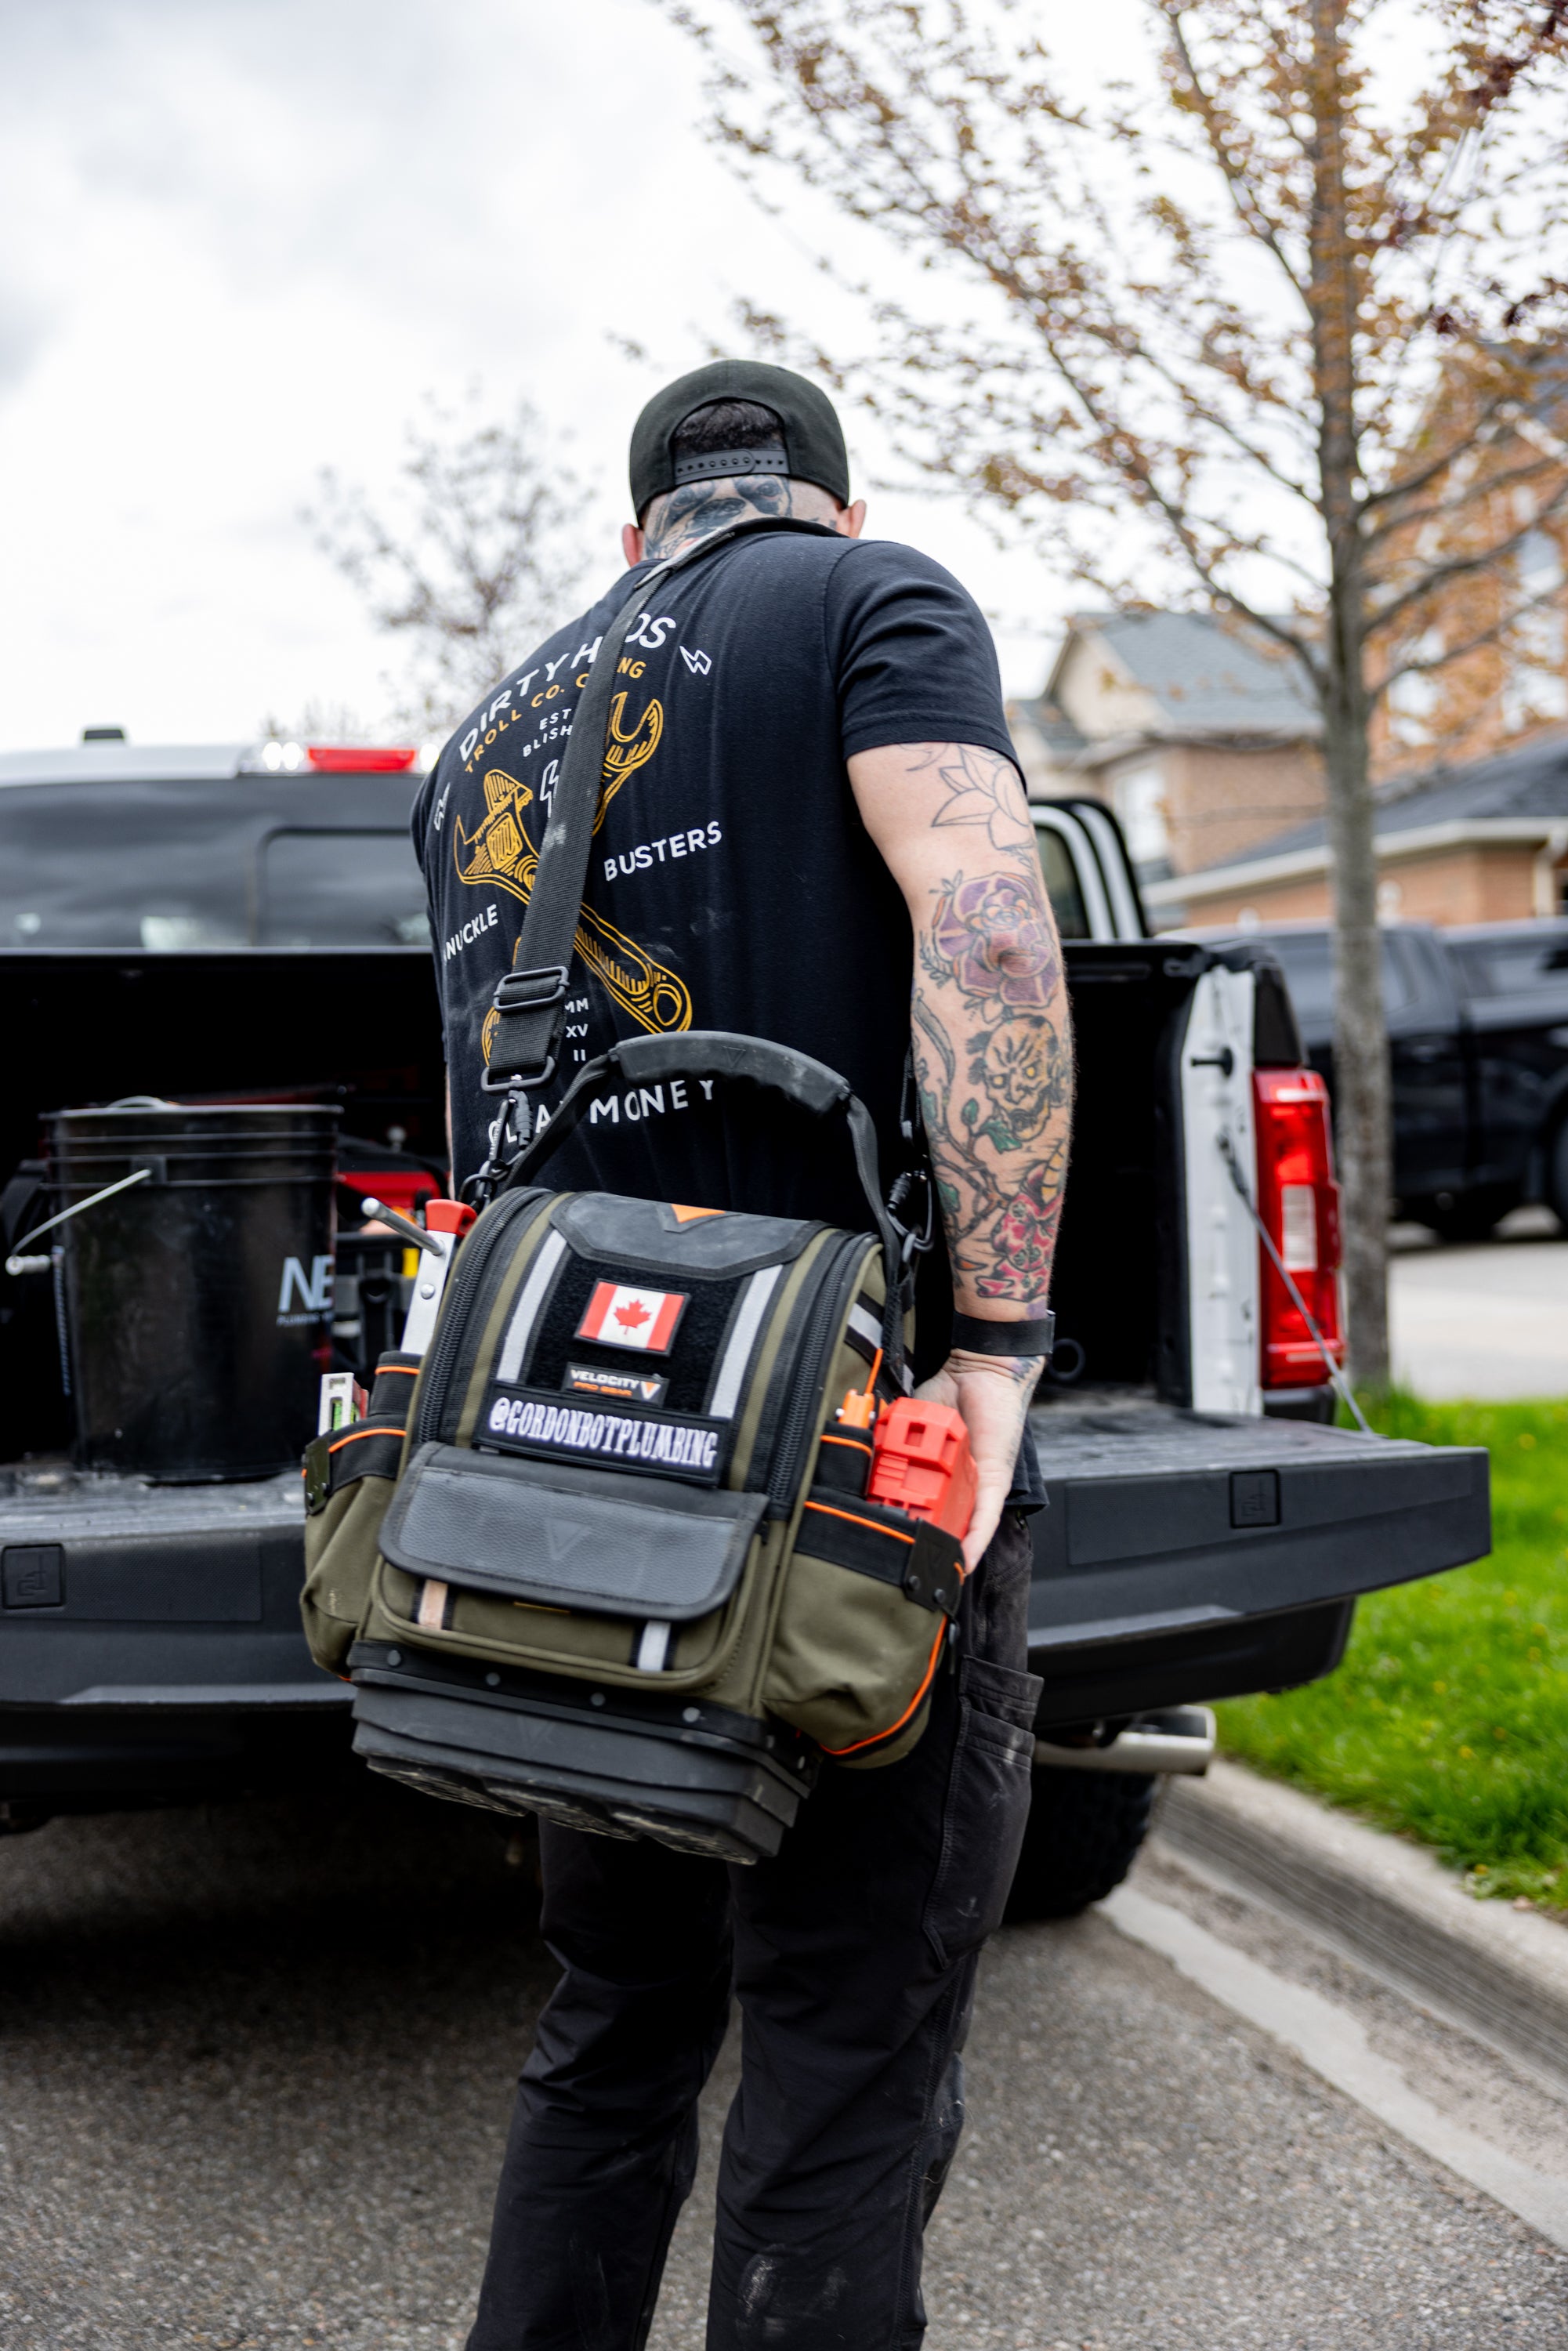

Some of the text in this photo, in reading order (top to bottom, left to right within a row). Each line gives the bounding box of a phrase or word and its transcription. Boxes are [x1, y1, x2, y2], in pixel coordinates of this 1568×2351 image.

[465, 684, 565, 773] TROLL CO.
[539, 708, 573, 730] EST
[523, 725, 574, 758] BLISH
[603, 820, 722, 882] BUSTERS
[565, 1023, 588, 1038] XV
[589, 1079, 714, 1124] MONEY
[570, 1369, 640, 1389] VELOCITY
[489, 1397, 718, 1468] @GORDONBOTPLUMBING
